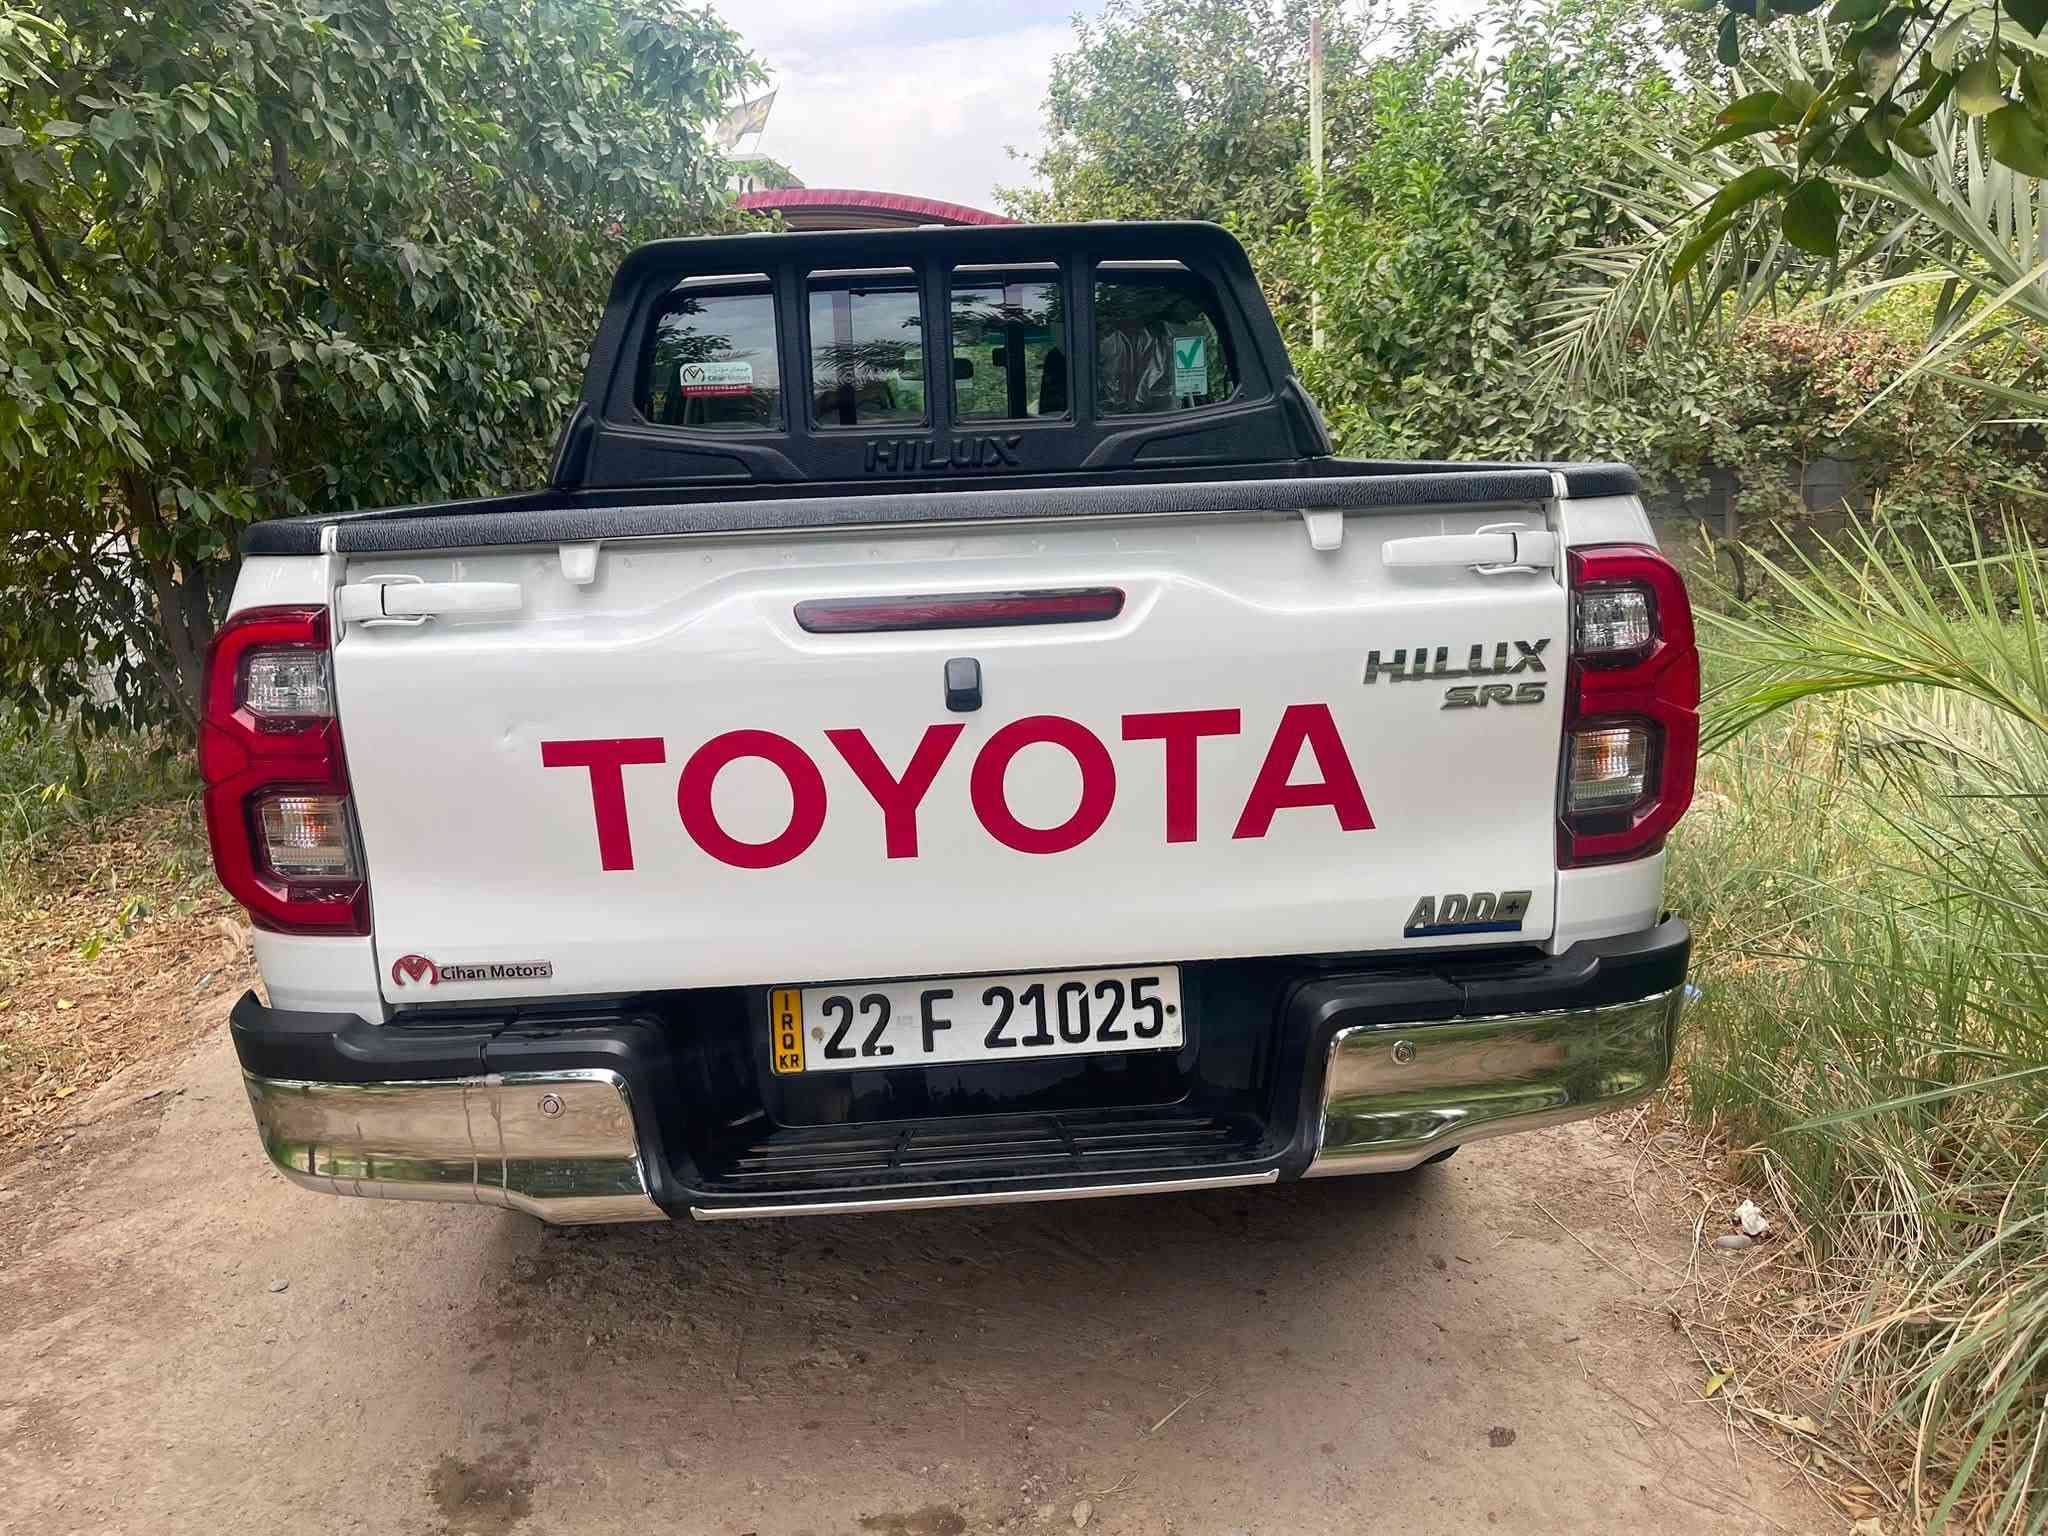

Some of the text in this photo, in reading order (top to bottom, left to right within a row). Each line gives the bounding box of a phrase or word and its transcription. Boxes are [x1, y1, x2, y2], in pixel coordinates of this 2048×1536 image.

[864, 434, 1022, 473] HILUX
[1363, 638, 1551, 684] HILUX
[1440, 681, 1548, 710] SR5
[541, 703, 1376, 871] TOYOTA
[441, 963, 547, 981] Cihan Motors
[822, 976, 1165, 1059] 22 F 21025
[780, 1054, 799, 1069] KR
